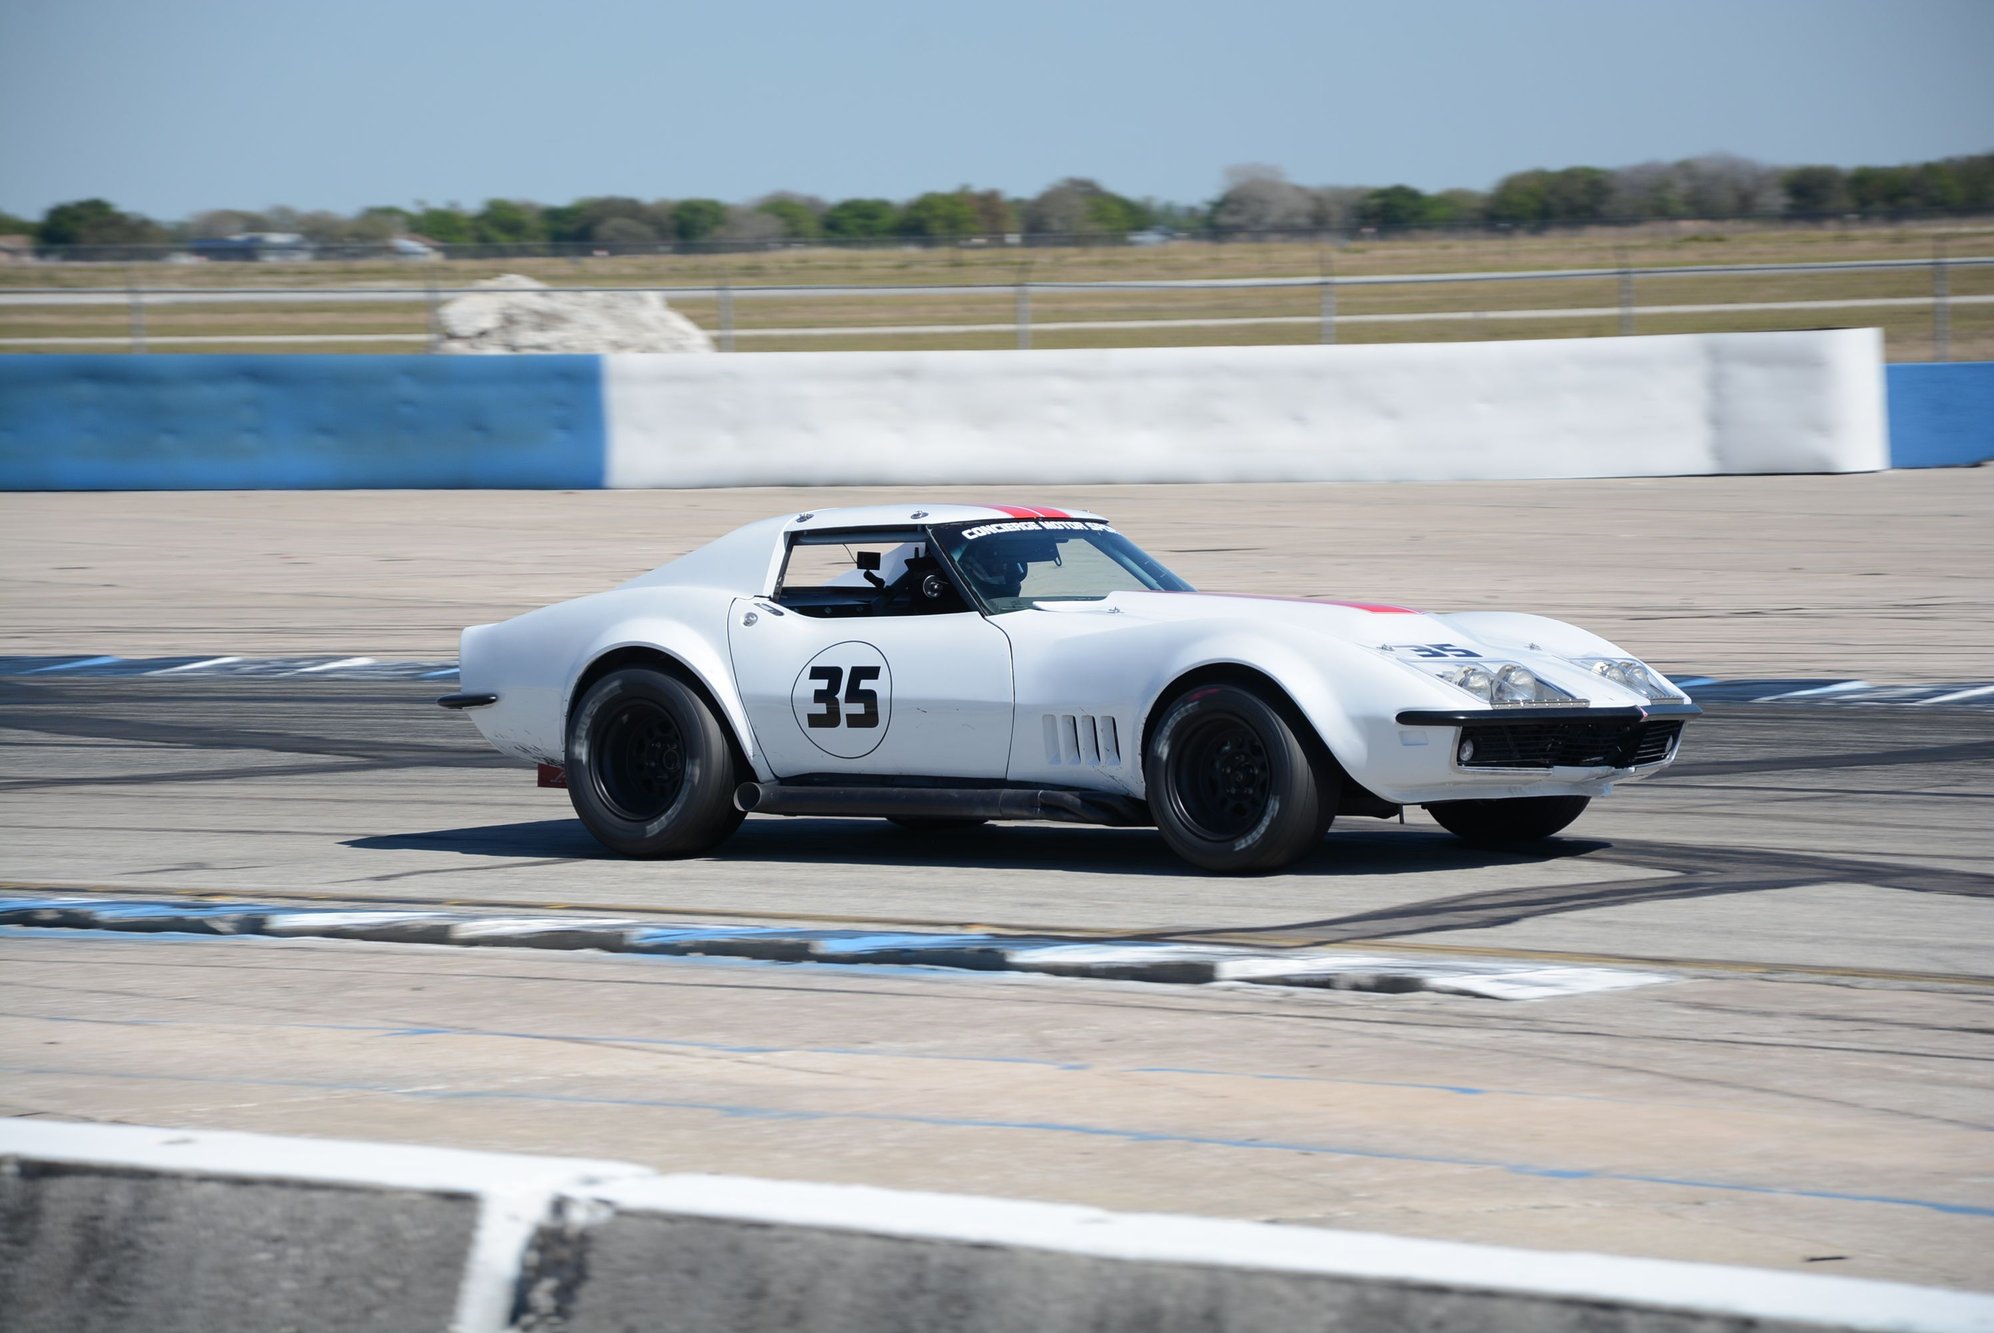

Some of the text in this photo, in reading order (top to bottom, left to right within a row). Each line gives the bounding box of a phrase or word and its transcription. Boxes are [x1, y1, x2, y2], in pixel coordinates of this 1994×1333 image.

[961, 521, 1042, 540] CONCIERGE
[1038, 520, 1089, 530] MOTOR
[1393, 643, 1484, 658] 35
[806, 665, 881, 729] 35
